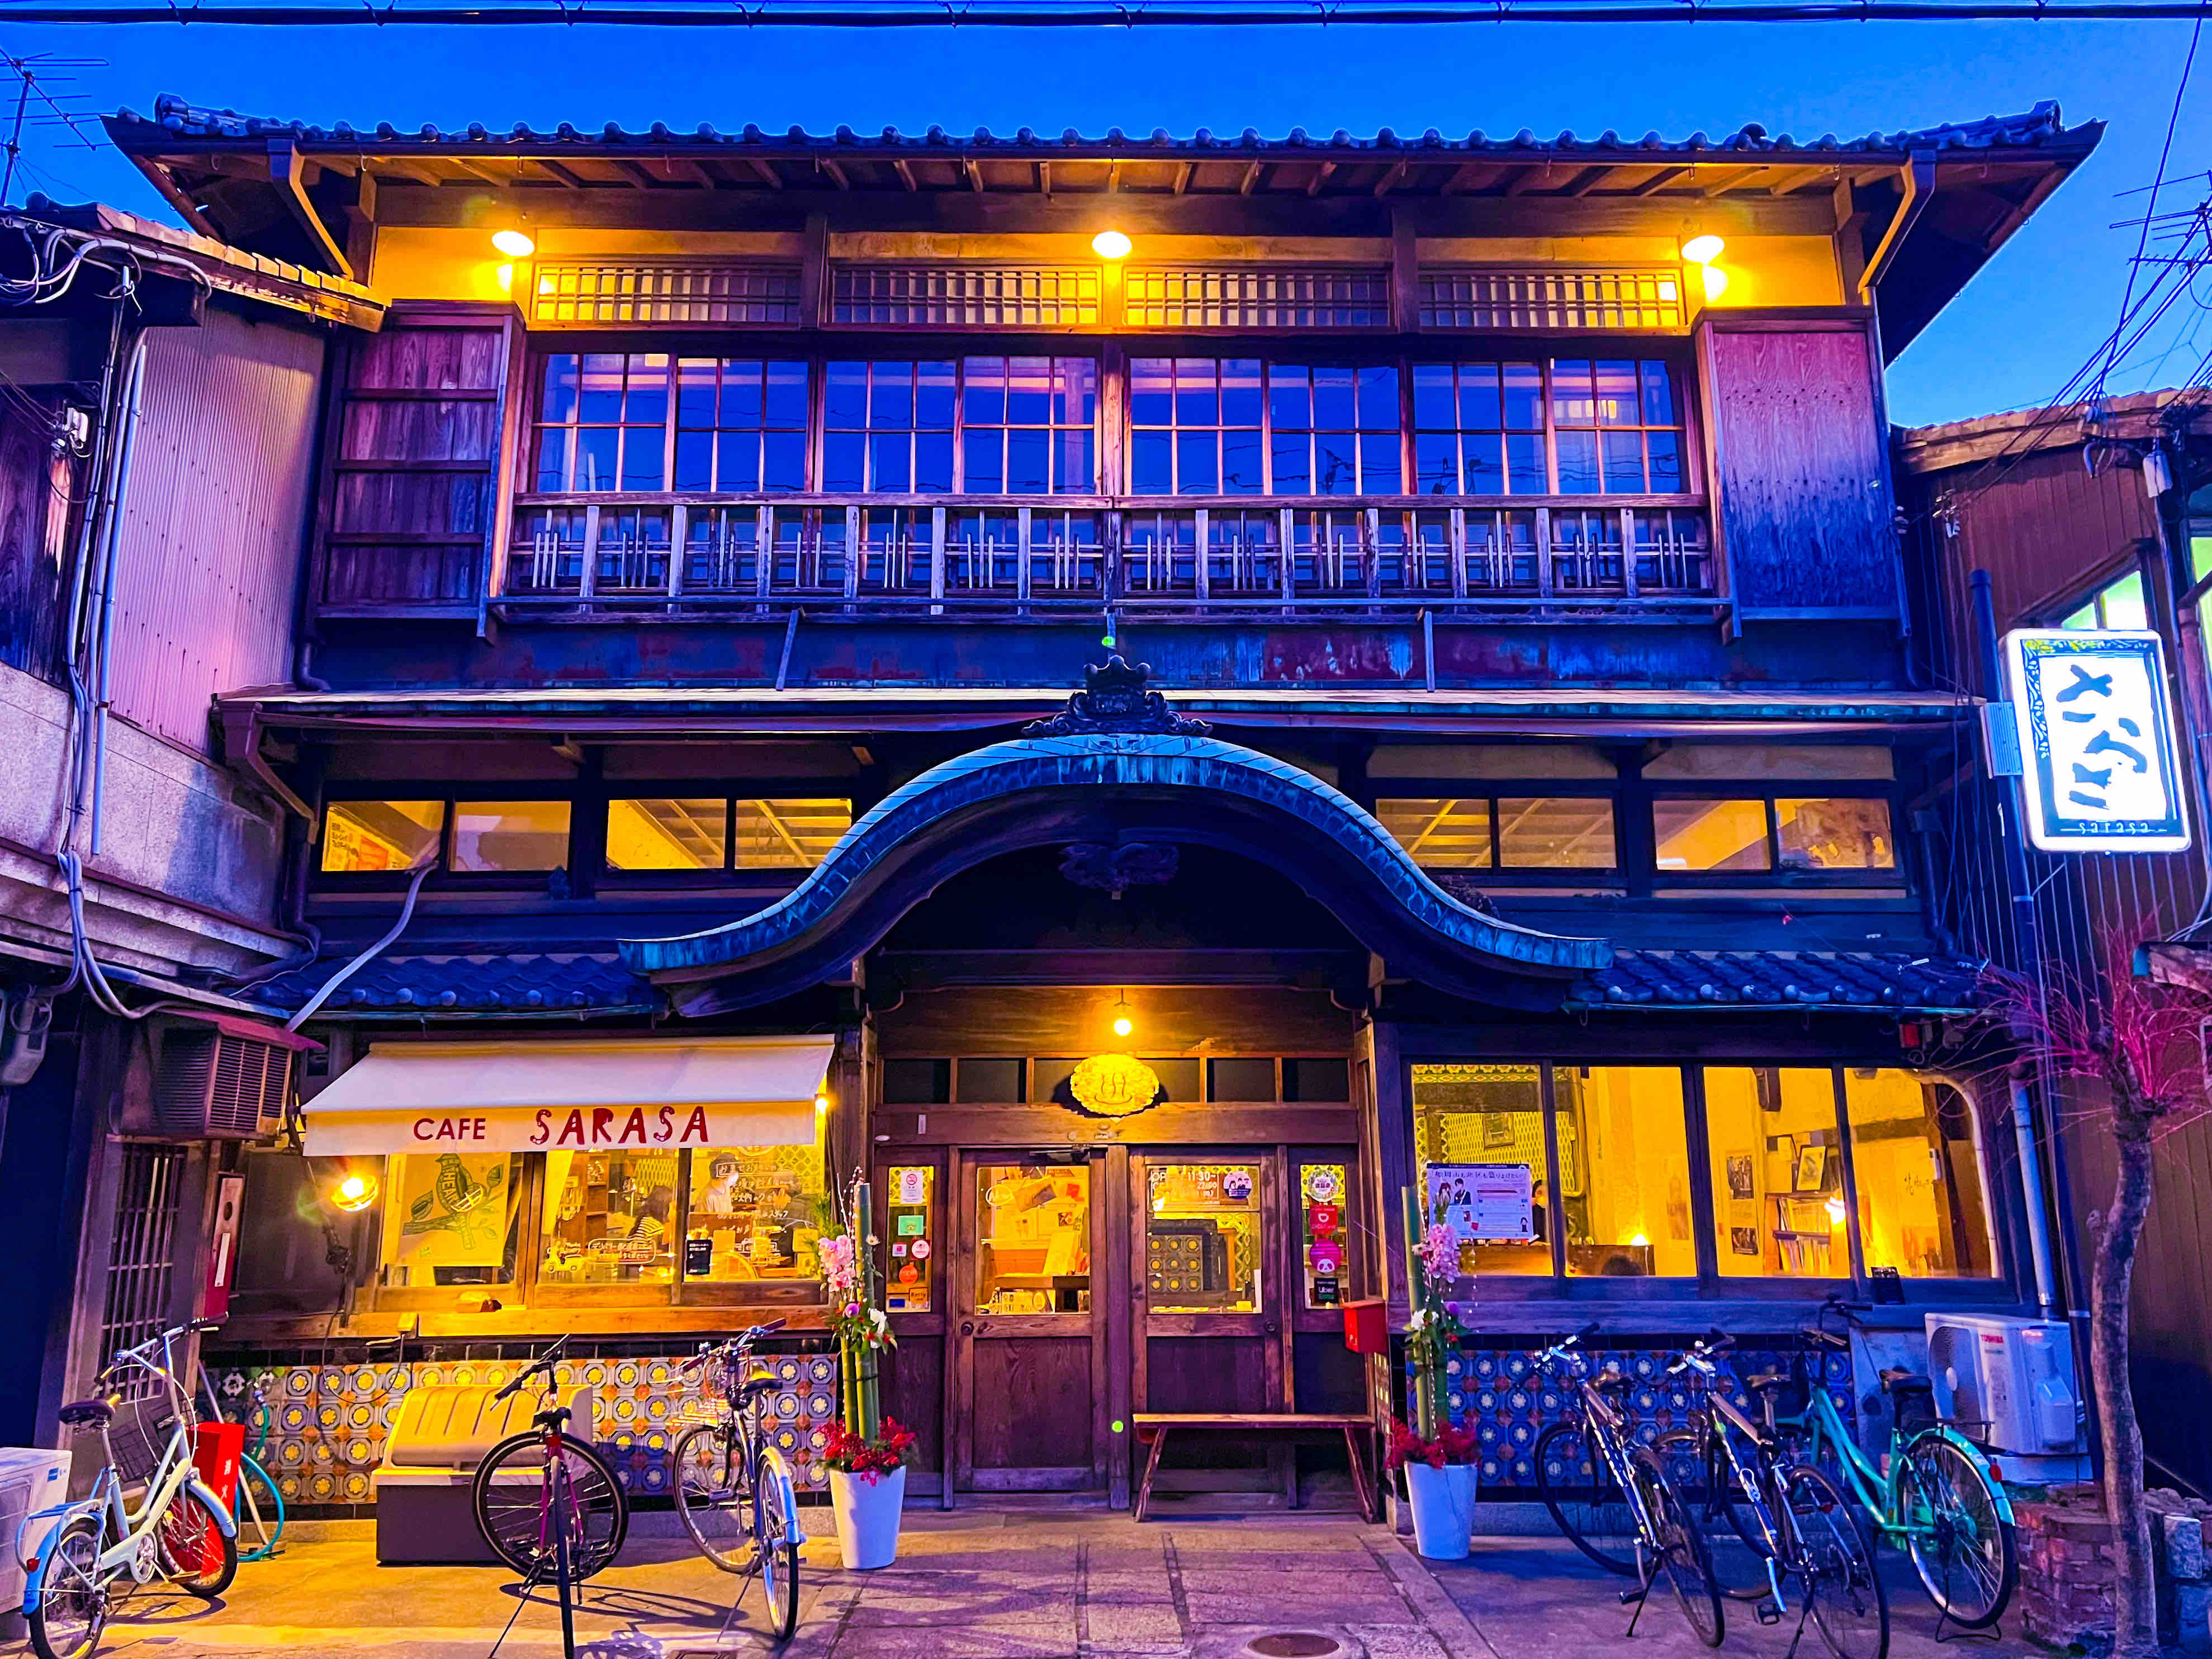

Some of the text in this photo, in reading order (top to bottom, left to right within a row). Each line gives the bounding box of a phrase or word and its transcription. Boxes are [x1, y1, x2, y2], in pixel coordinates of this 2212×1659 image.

[2078, 822, 2149, 835] sarasa
[413, 1106, 709, 1145] CAFE SARASA
